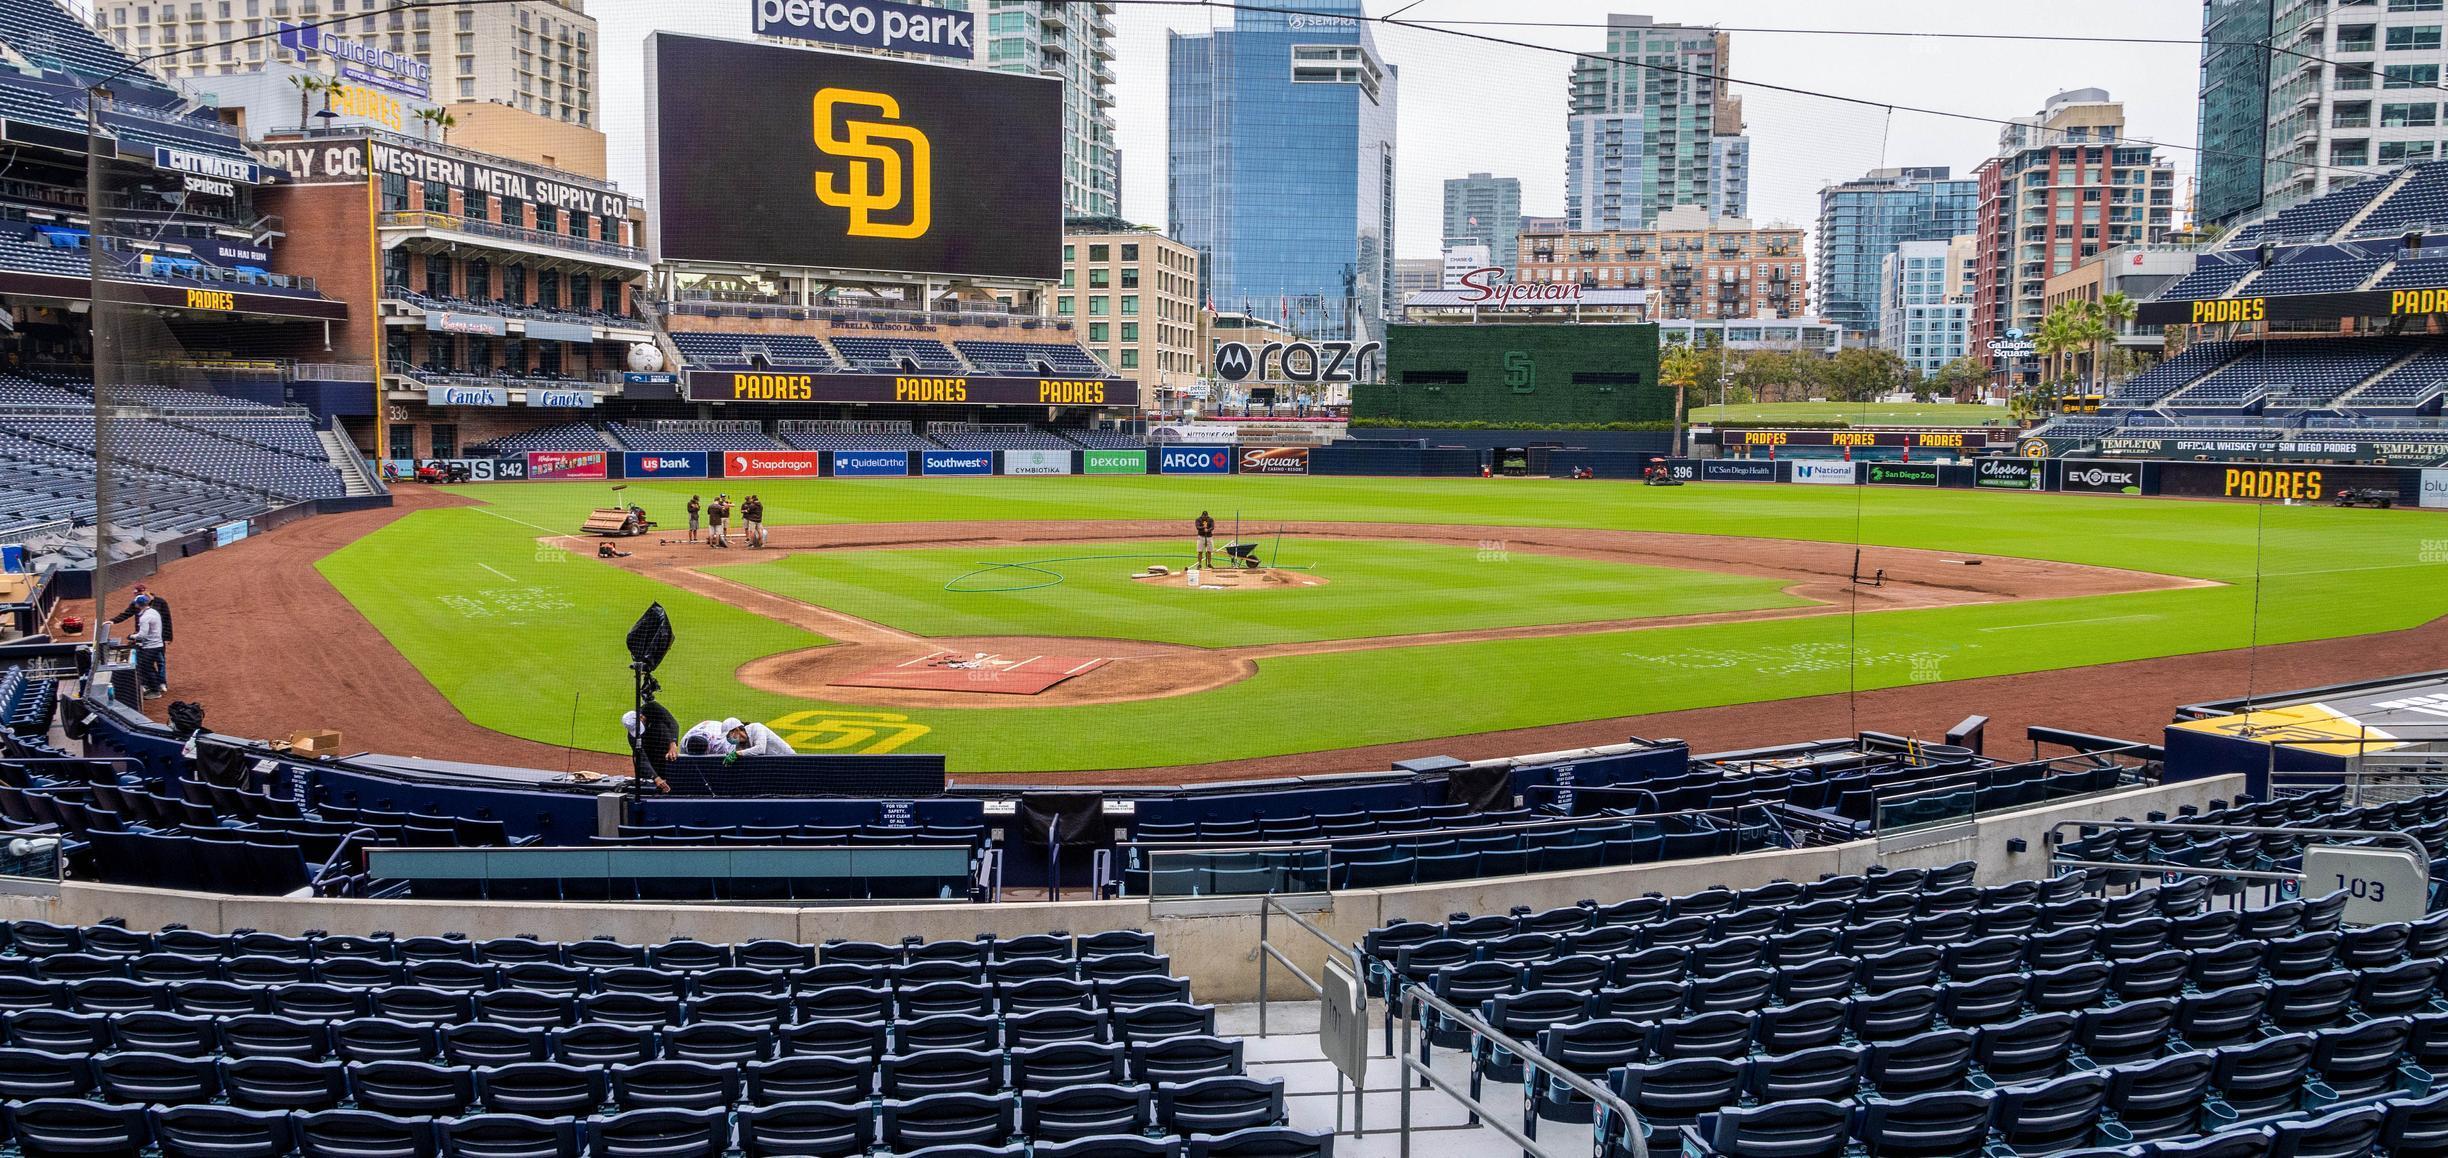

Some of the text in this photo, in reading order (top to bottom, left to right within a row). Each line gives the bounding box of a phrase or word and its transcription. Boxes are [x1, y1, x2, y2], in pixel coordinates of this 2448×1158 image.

[757, 0, 970, 48] petco park
[1308, 16, 1357, 26] SEMPRA
[323, 33, 430, 82] QuidelOrtho
[331, 85, 400, 132] PADRES
[169, 150, 250, 181] CUTWATER
[325, 146, 368, 176] CO.
[813, 87, 931, 239] SD
[184, 176, 234, 198] SPIRITS
[371, 144, 627, 219] WESTERN METAL SUPPLY CO.
[219, 247, 267, 261] BALI HAI RUM
[1458, 266, 1585, 311] Sycuan
[187, 289, 234, 311] PADRES
[2193, 298, 2264, 323] PADRES
[831, 322, 869, 330] ESTRELLA
[872, 322, 901, 331] JALISCO
[1258, 341, 1381, 382] razr
[1994, 349, 2030, 358] Square
[734, 374, 812, 400] PADRES
[896, 377, 966, 402] PADRES
[1040, 380, 1104, 404] PADRES
[446, 387, 494, 406] Canel's
[542, 391, 584, 407] Canel's
[389, 407, 408, 421] 336
[1919, 433, 1963, 447] PADRES
[2101, 440, 2161, 449] TEMPLETON
[2177, 442, 2214, 450] OFFICIAL
[2217, 442, 2257, 451] WHISKEY
[2278, 443, 2296, 451] SAN
[2298, 443, 2321, 452] DIEGO
[2324, 444, 2357, 453] PADRES
[644, 457, 690, 469] us bank
[751, 459, 812, 471] Snapdragon
[851, 459, 905, 468] QuidelOrtho
[927, 458, 981, 468] Southwest
[1163, 454, 1210, 468] ARCO
[1243, 449, 1302, 472] Sycuan
[1981, 460, 2027, 475] Chosen
[500, 462, 523, 477] 342
[1673, 466, 1693, 478] 396
[1709, 466, 1719, 474] UC
[1732, 466, 1749, 475] Diego
[1749, 467, 1770, 475] Health
[1814, 466, 1851, 474] National
[1900, 471, 1920, 480] Diego
[2069, 469, 2132, 486] EVOTEK
[2225, 469, 2321, 499] PADRES
[2424, 479, 2448, 492] blu
[2336, 873, 2385, 903] 103
